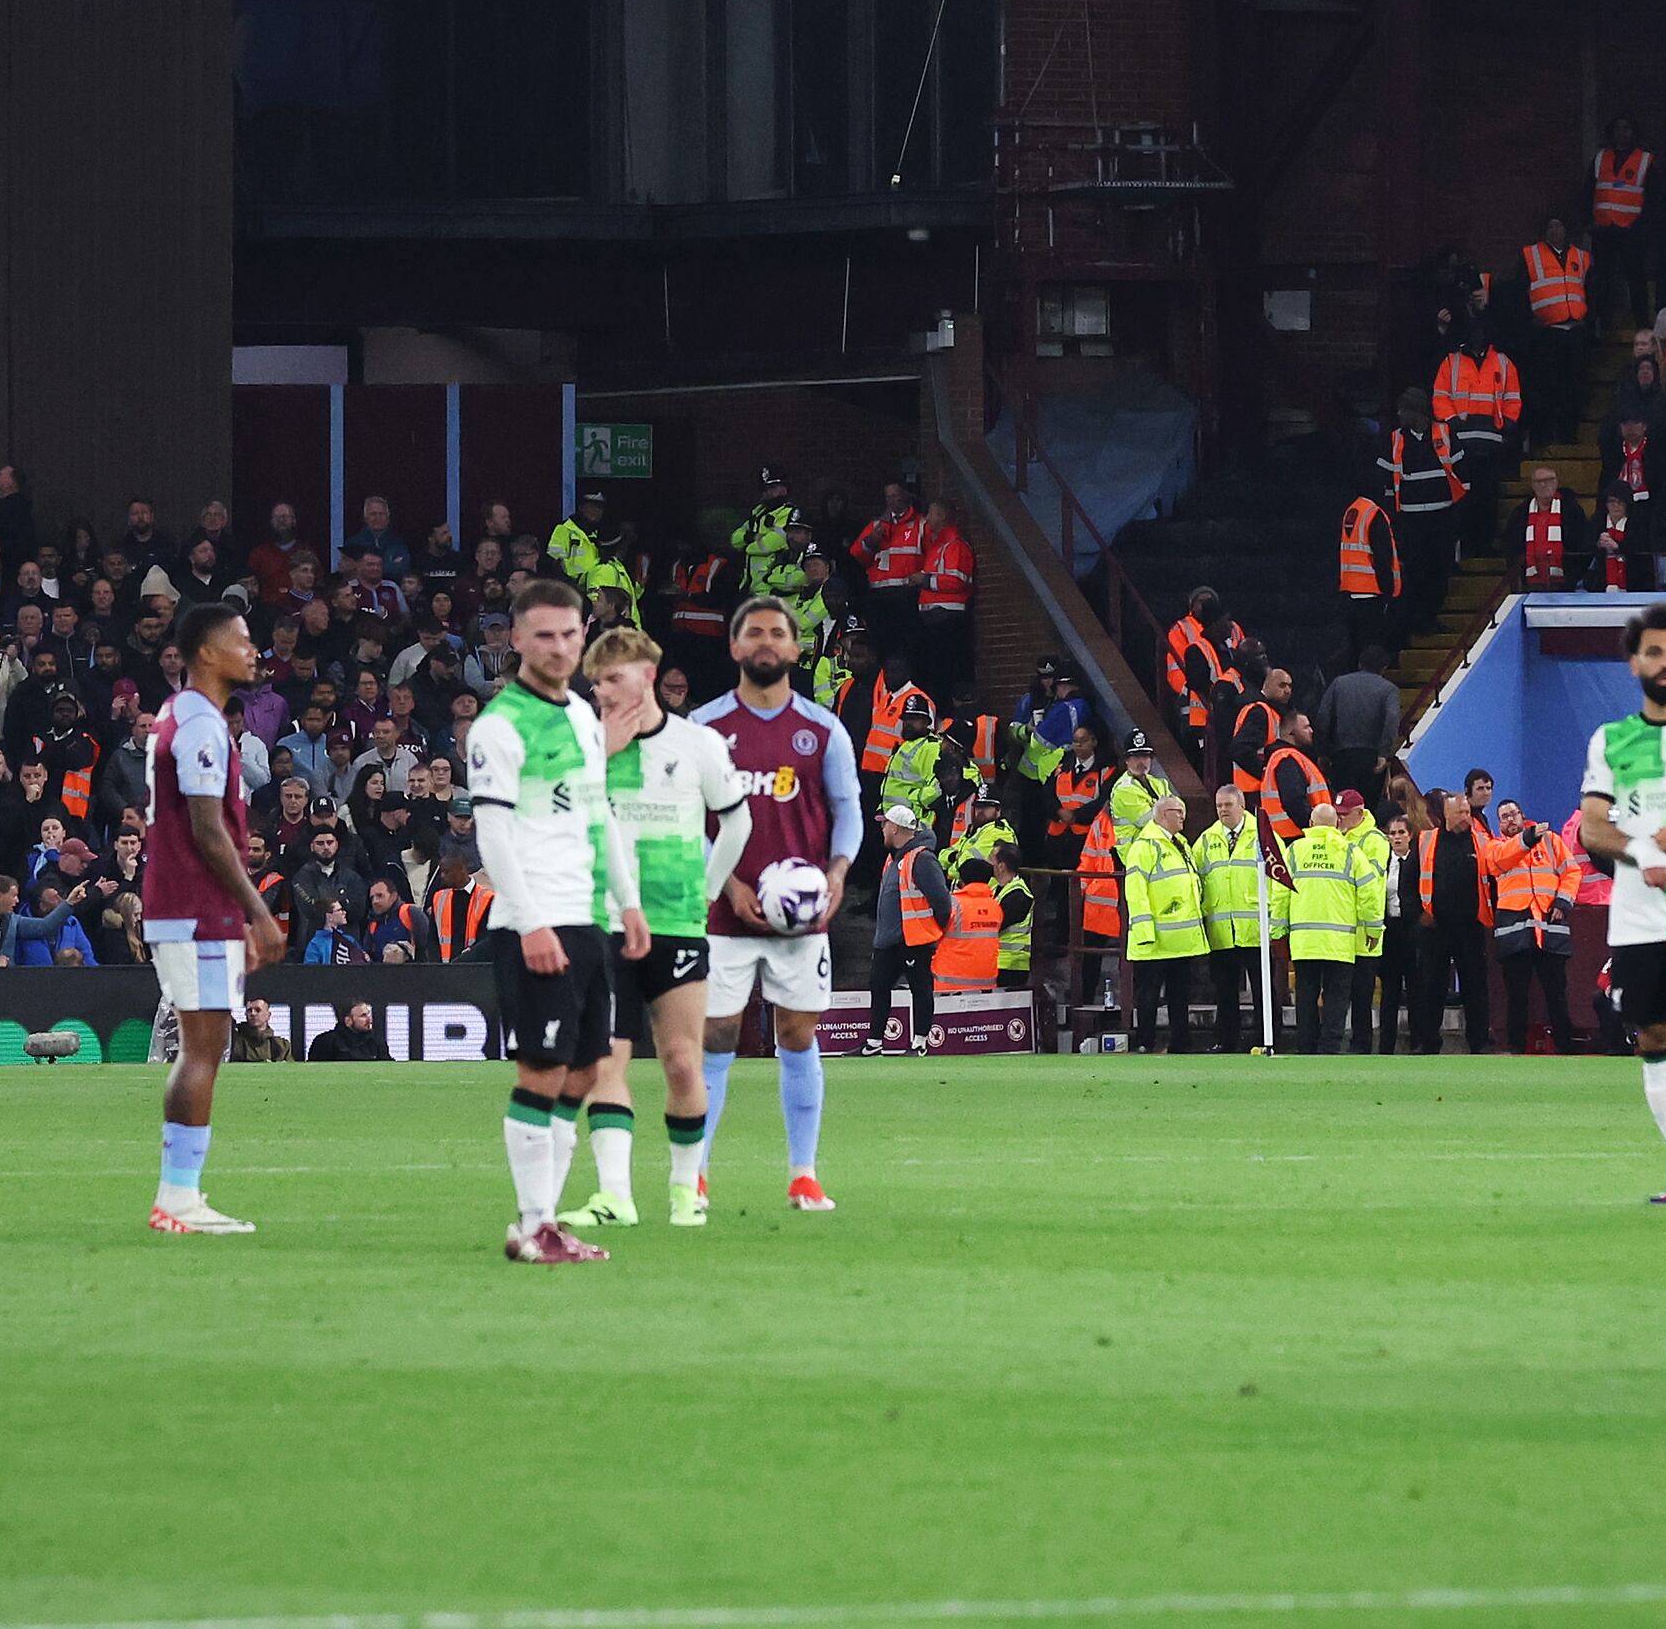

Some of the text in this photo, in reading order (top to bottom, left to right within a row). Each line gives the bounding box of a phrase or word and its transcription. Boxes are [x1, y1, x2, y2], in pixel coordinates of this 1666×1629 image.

[617, 435, 650, 450] Fire
[617, 452, 648, 468] exit
[1303, 862, 1336, 870] OFFICER
[817, 946, 829, 978] 6
[947, 1024, 1005, 1035] NO UNAUTHORISED
[830, 1031, 859, 1040] ACCESS
[964, 1034, 988, 1044] ACCESS
